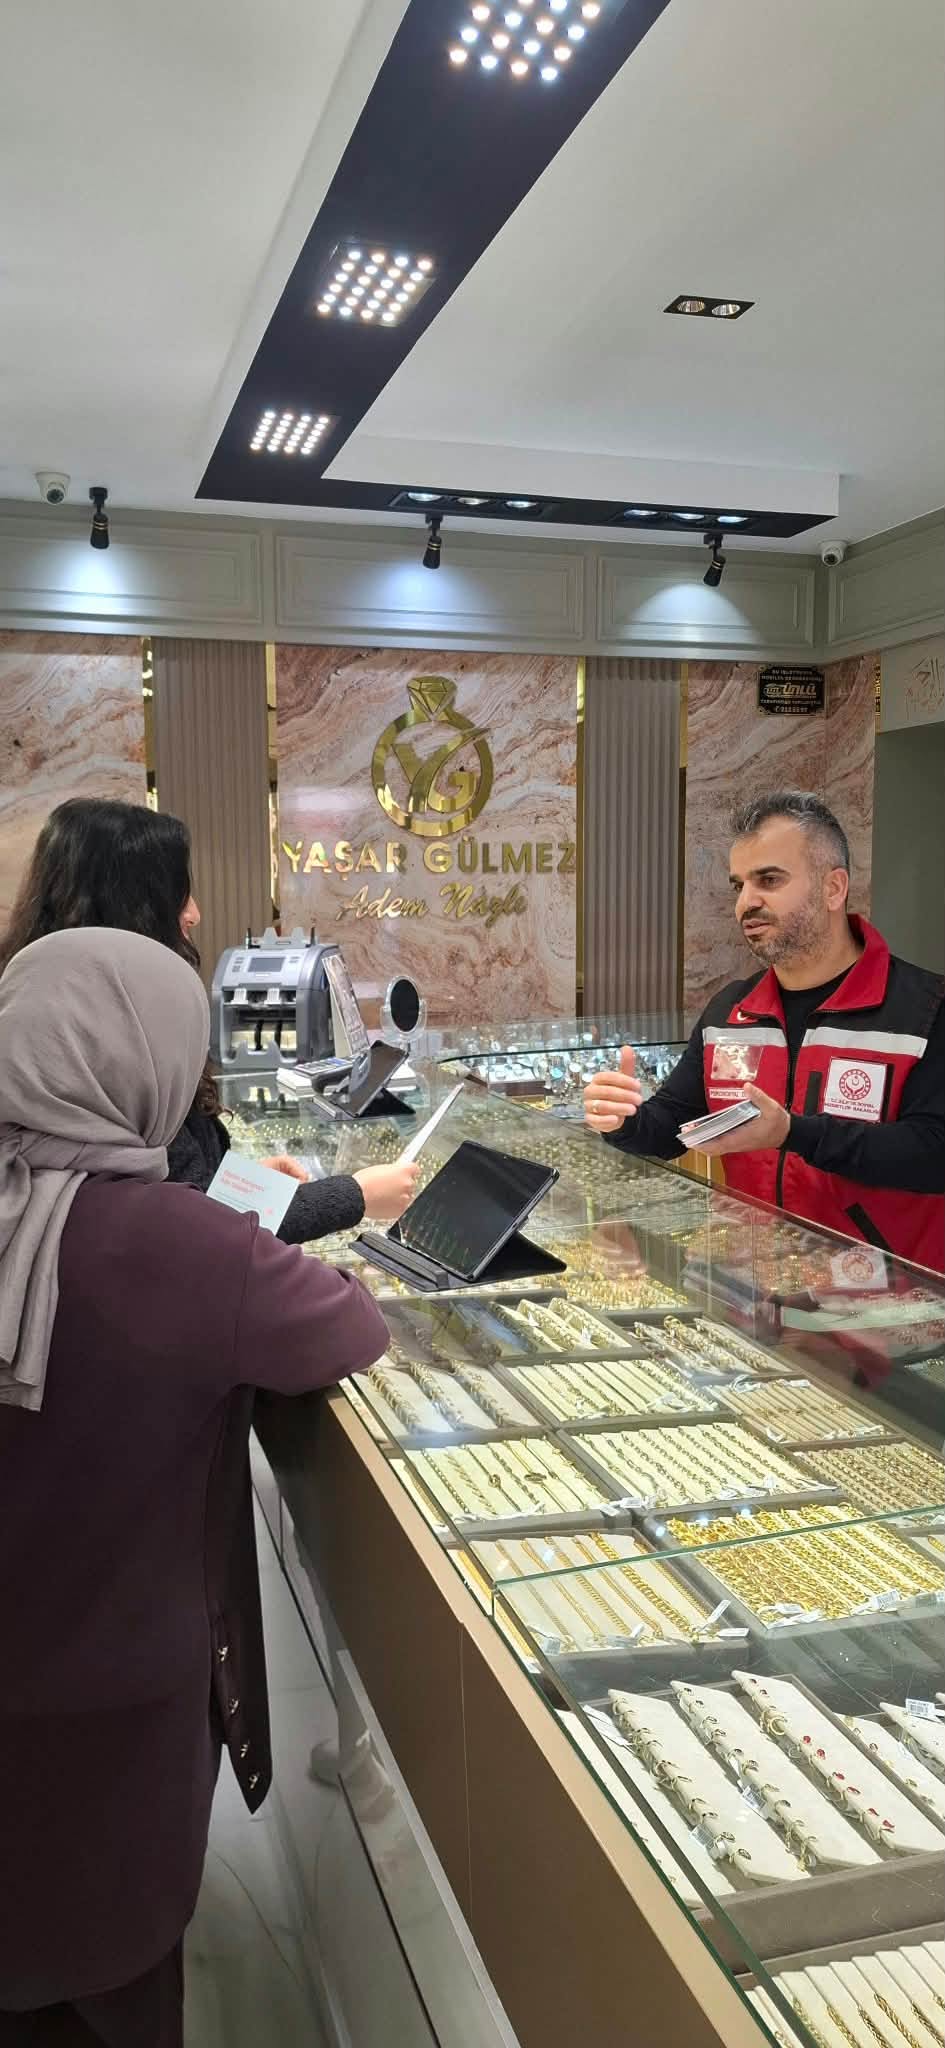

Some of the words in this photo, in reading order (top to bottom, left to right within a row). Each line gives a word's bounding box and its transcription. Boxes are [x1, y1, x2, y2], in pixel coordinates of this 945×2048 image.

[282, 841, 407, 881] YAŞAR
[423, 836, 576, 873] GÜLMEZ
[336, 885, 430, 920] Adem
